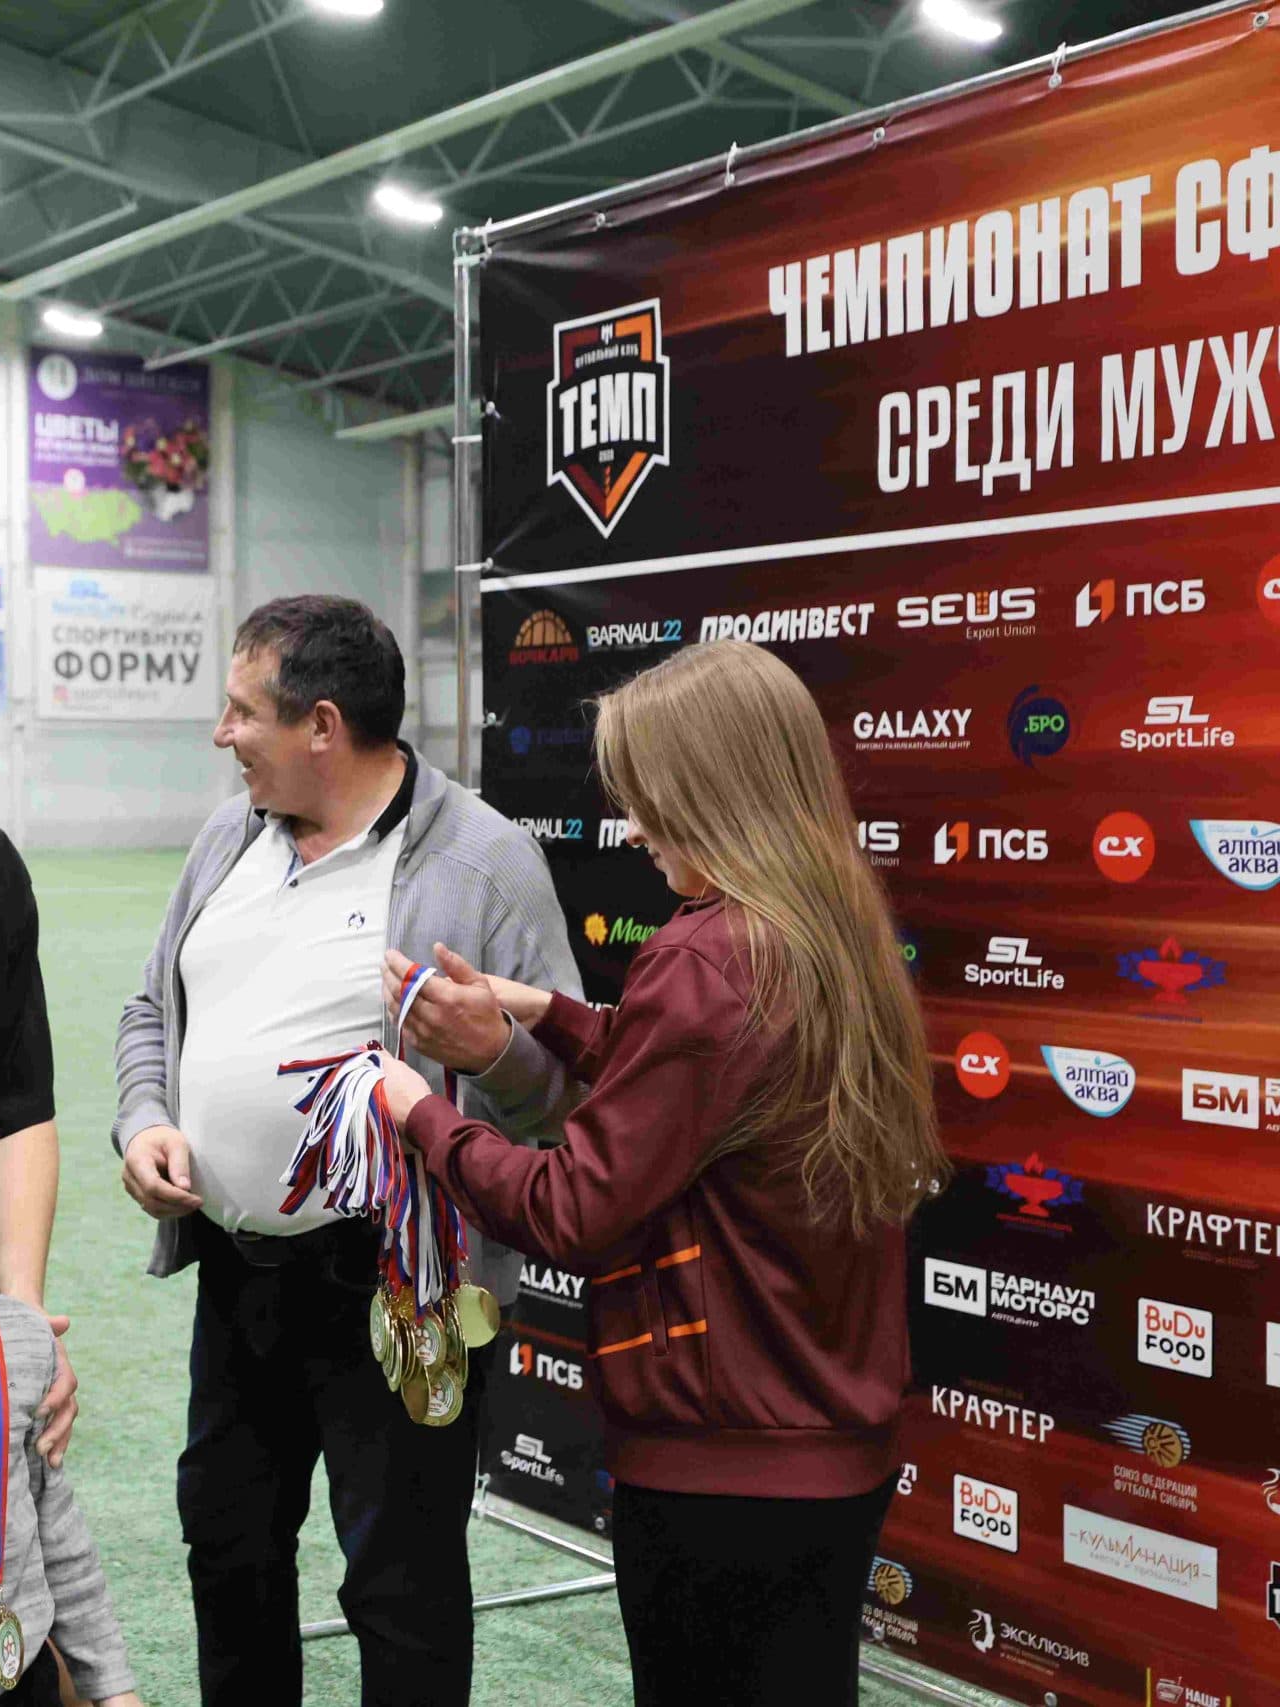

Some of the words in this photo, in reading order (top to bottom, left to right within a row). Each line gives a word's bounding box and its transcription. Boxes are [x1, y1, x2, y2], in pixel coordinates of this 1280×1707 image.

[769, 175, 1151, 357] ЧЕМПИОНАТ
[559, 372, 657, 458] ТЕМП
[877, 361, 1075, 496] СРЕДИ
[1101, 325, 1280, 463] МУЖ
[897, 587, 1036, 628] SEUS
[1126, 579, 1206, 617] ПСБ
[587, 619, 681, 648] BARNAUL22
[700, 602, 874, 643] ПРОДИНВЕСТ
[966, 626, 1000, 640] Export
[1004, 624, 1036, 637] Union
[54, 649, 200, 684] ФОРМУ
[853, 708, 972, 739] GALAXY
[1120, 727, 1235, 751] SportLife
[511, 818, 583, 840] ARNAUL22
[979, 828, 1049, 861] ПСБ
[1229, 857, 1279, 873] аква
[609, 917, 659, 945] Мар
[964, 964, 1065, 989] SportLife
[1065, 1064, 1129, 1087] алтай
[1075, 1083, 1119, 1102] аква
[1192, 1083, 1249, 1115] БМ
[1147, 1202, 1280, 1257] КРАФТЕ
[519, 1264, 585, 1299] ALAXY
[933, 1271, 979, 1302] БМ
[991, 1270, 1095, 1309] БАРНАУЛ
[991, 1290, 1090, 1326] МОТОРС
[1144, 1305, 1205, 1339] BuDu
[1145, 1334, 1205, 1361] FOOD
[536, 1353, 583, 1389] ПСБ
[932, 1384, 1055, 1442] КРАФТЕР
[501, 1449, 565, 1486] SportLife
[1113, 1464, 1140, 1481] СОЮЗ
[1142, 1471, 1198, 1499] ФЕДЕРАЦИЙ
[960, 1481, 1012, 1516] BuDu
[1113, 1479, 1158, 1501] ФУТБОЛА
[960, 1508, 1012, 1536] FOOD
[1078, 1529, 1200, 1580] КУЛЬМИНАЦИЯ
[1000, 1622, 1090, 1668] ЭКСКЛЮЗИВ
